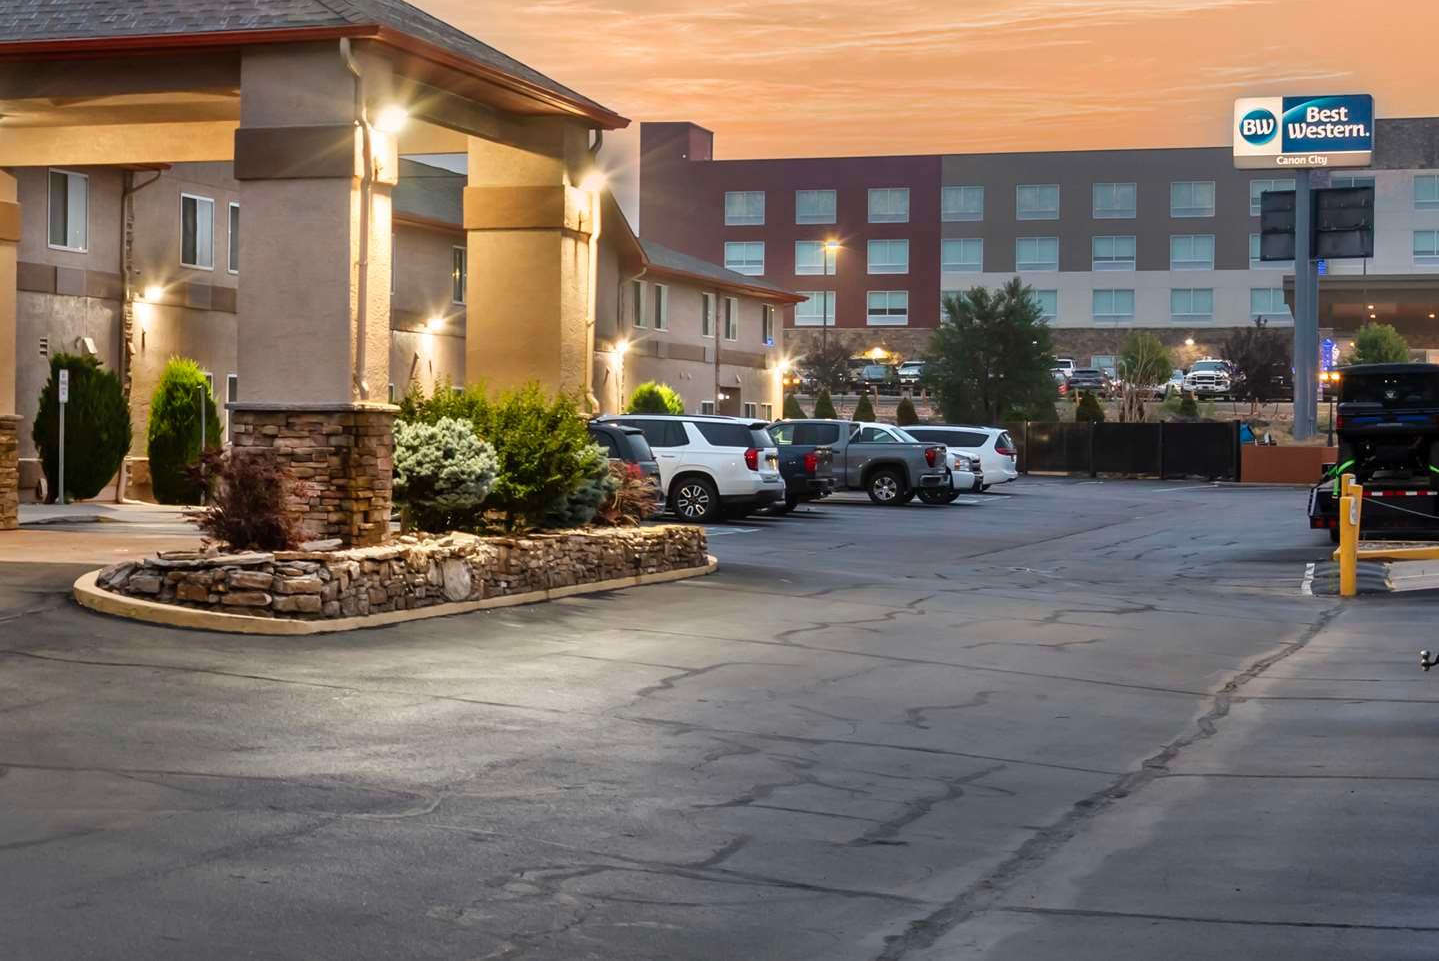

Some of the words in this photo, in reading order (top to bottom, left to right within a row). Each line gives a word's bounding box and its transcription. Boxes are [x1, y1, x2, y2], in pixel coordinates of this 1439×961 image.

[1306, 106, 1348, 122] Best
[1243, 118, 1275, 136] BW
[1276, 155, 1306, 166] Canon
[1308, 154, 1328, 165] City
